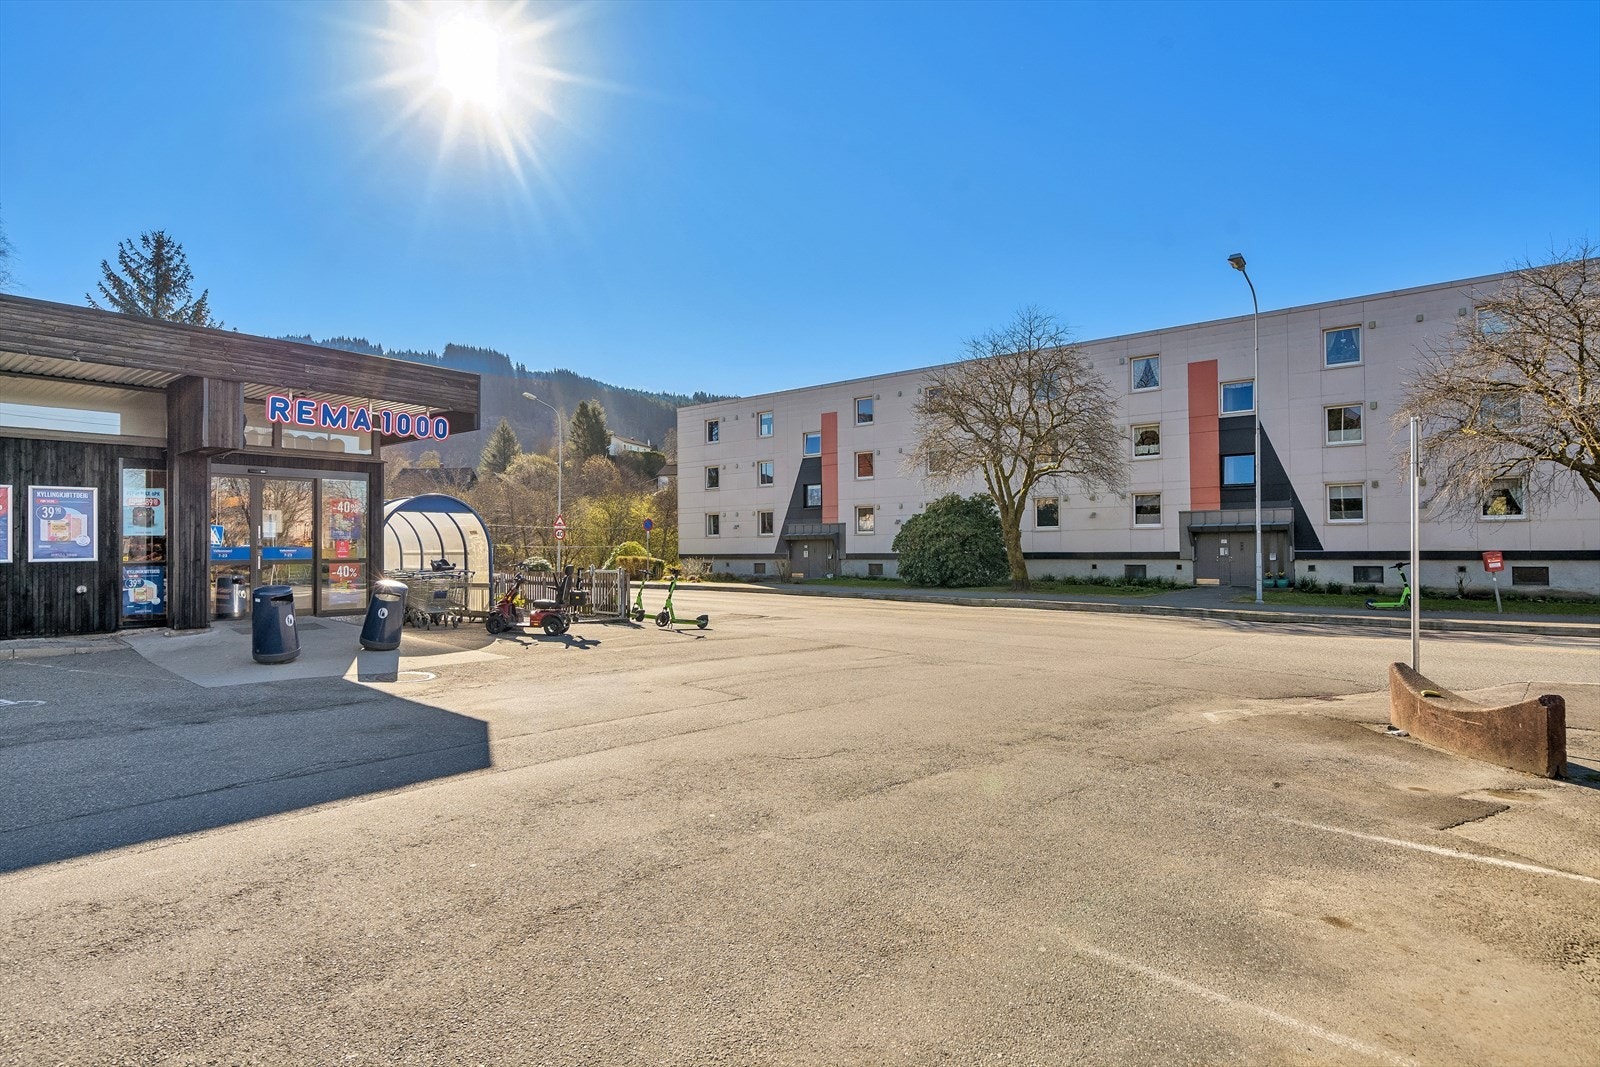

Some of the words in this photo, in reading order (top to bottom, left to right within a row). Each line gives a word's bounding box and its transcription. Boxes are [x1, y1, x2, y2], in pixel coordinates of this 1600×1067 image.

[266, 394, 374, 432] REMA
[379, 409, 451, 441] 1000
[333, 501, 359, 514] -40%
[331, 565, 358, 578] -40%
